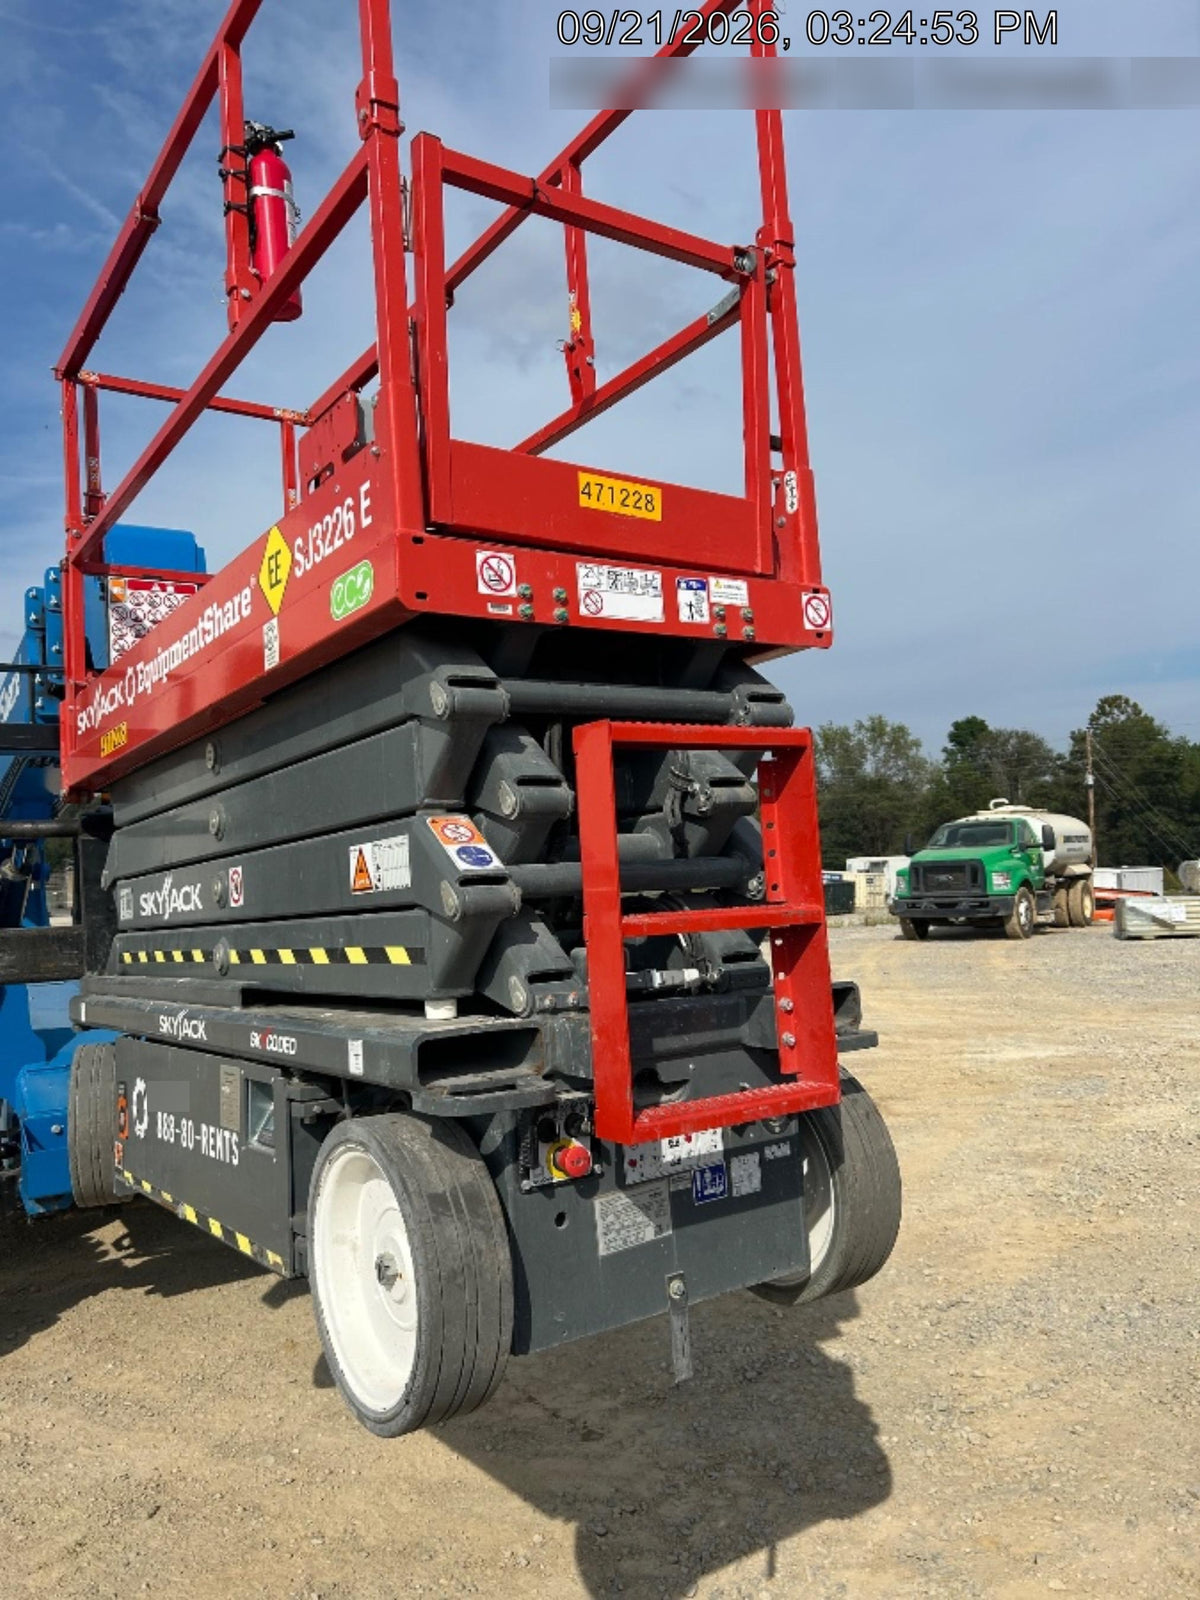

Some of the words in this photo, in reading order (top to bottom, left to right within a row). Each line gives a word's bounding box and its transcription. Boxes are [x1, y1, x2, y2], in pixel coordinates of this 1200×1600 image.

[580, 481, 656, 513] 471228
[294, 496, 356, 579] SJ3226
[360, 479, 373, 529] E
[267, 548, 283, 590] EE
[136, 585, 252, 695] EquipmentShare
[77, 682, 125, 735] SKYJACK
[139, 871, 203, 920] SKYJACK
[159, 1009, 208, 1041] SKYJACK
